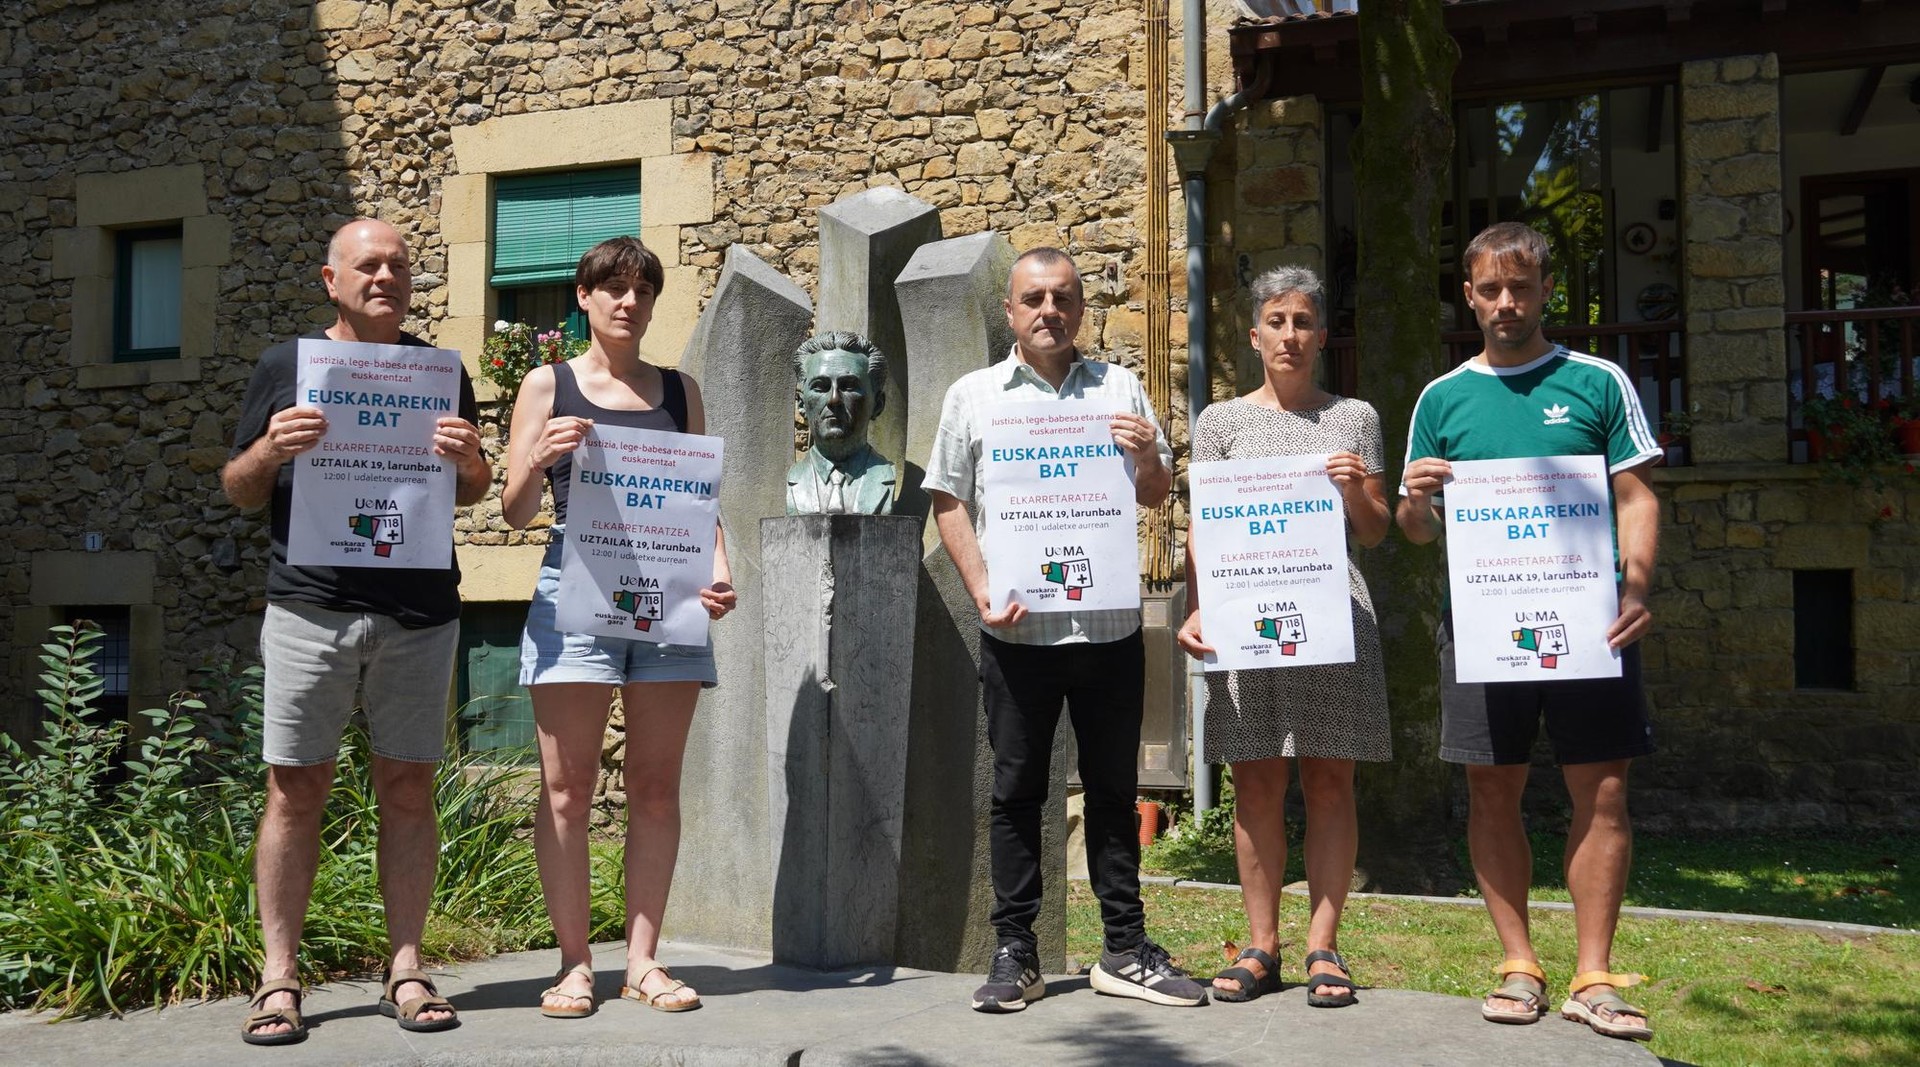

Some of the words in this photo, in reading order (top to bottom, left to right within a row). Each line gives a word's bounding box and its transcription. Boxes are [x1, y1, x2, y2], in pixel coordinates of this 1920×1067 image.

[309, 355, 347, 366] Justizia,
[349, 358, 407, 370] lege-babesa
[408, 363, 423, 371] eta
[425, 364, 453, 374] arnasa
[351, 372, 412, 383] euskarentzat
[308, 389, 450, 411] EUSKARAREKIN
[358, 411, 401, 428] BAT
[992, 415, 1025, 426] Justizia,
[1026, 414, 1079, 424] lege-babesa
[1080, 413, 1094, 421] eta
[1029, 426, 1085, 436] euskarentzat
[323, 442, 429, 456] ELKARRETARATZEA
[584, 438, 618, 450] Justizia,
[620, 442, 672, 456] lege-babesa
[673, 448, 686, 456] eta
[688, 450, 715, 459] arnasa
[992, 444, 1124, 462] EUSKARAREKIN
[311, 458, 368, 469] UZTAILAK
[371, 460, 385, 471] 19,
[387, 461, 442, 473] larunbata
[622, 455, 676, 467] euskarentzat
[1040, 463, 1078, 479] BAT
[1199, 473, 1233, 485] Justizia,
[1233, 471, 1287, 483] lege-babesa
[1288, 470, 1302, 479] eta
[1303, 469, 1327, 477] arnas
[1491, 472, 1549, 484] lege-babesa
[1551, 472, 1566, 480] eta
[1566, 471, 1597, 479] arnasa
[323, 473, 345, 481] 12:00
[354, 473, 393, 483] udaletxe
[394, 476, 427, 485] aurrean
[580, 470, 712, 495] EUSKARAREKIN
[1237, 483, 1293, 494] euskarentzat
[1495, 484, 1556, 495] euskarentzat
[626, 493, 665, 510] BAT
[1010, 493, 1108, 505] ELKARRETARATZEA
[1000, 510, 1053, 521] UZTAILAK
[1056, 510, 1069, 519] 19,
[1071, 508, 1121, 518] larunbata
[1202, 499, 1333, 520] EUSKARAREKIN
[1456, 503, 1599, 522] EUSKARAREKIN
[383, 518, 399, 528] 118
[592, 520, 690, 537] ELKARRETARATZEA
[1014, 524, 1034, 532] 12:00
[1042, 521, 1077, 531] udaletxe
[1078, 521, 1109, 530] aurrean
[1249, 519, 1288, 535] BAT
[1507, 523, 1550, 540] BAT
[89, 535, 95, 549] 1
[580, 534, 633, 548] UZTAILAK
[636, 540, 650, 551] 19,
[651, 542, 701, 553] larunbata
[344, 546, 362, 554] gara
[591, 549, 612, 558] 12:00
[620, 552, 656, 562] udaletxe
[656, 556, 688, 565] aurrean
[1221, 548, 1319, 563] ELKARRETARATZEA
[1072, 563, 1087, 573] 118
[1476, 554, 1583, 568] ELKARRETARATZEA
[1212, 567, 1264, 578] UZTAILAK
[1267, 566, 1281, 576] 19,
[1282, 563, 1333, 575] larunbata
[1466, 573, 1523, 584] UZTAILAK
[1526, 572, 1541, 582] 19,
[1543, 570, 1599, 581] larunbata
[1226, 581, 1246, 589] 12:00
[1253, 578, 1288, 588] udaletxe
[1289, 577, 1321, 586] aurrean
[1481, 588, 1502, 596] 12:00
[1511, 586, 1549, 596] udaletxe
[1551, 584, 1585, 595] aurrean
[644, 595, 659, 605] 118
[595, 612, 627, 621] euskaraz
[1285, 618, 1300, 628] 118
[1545, 629, 1561, 639] 118
[1496, 654, 1530, 662] euskaraz
